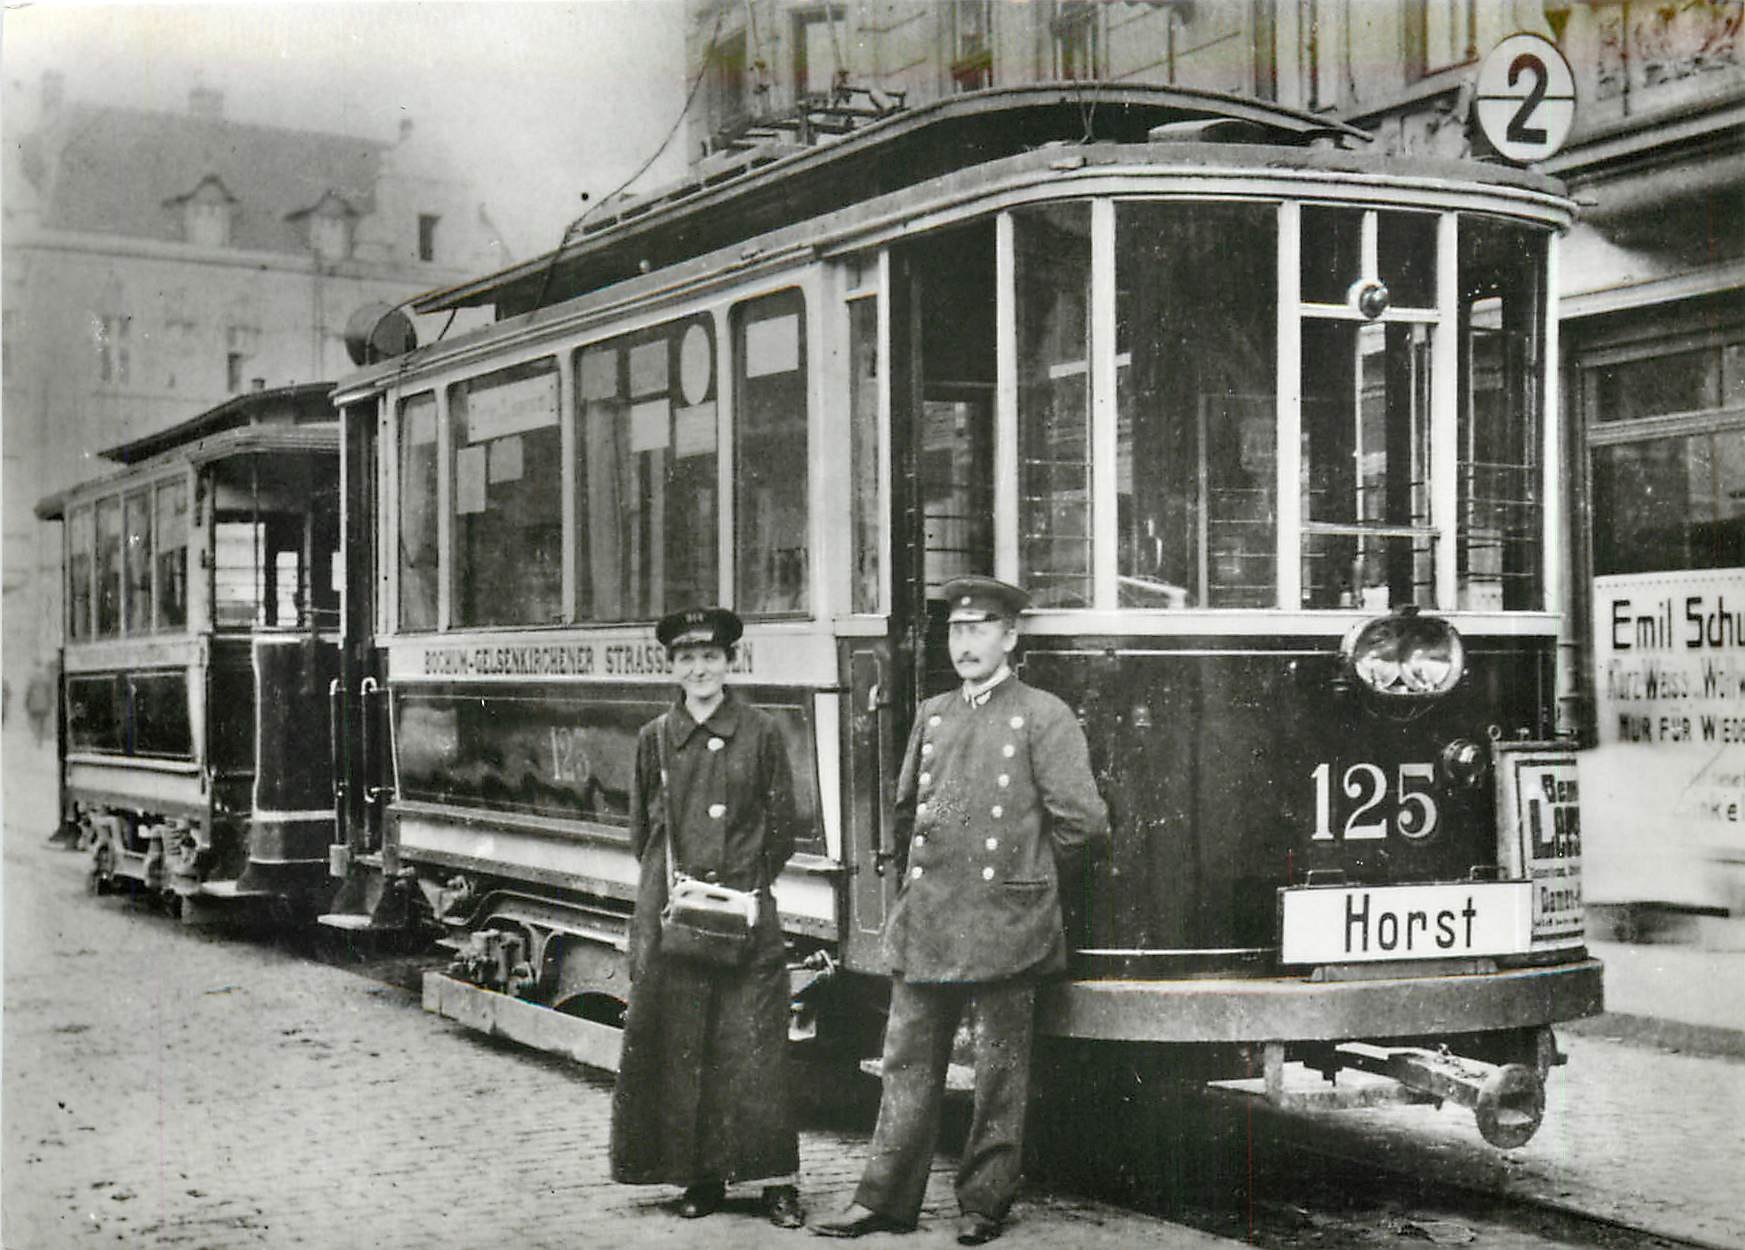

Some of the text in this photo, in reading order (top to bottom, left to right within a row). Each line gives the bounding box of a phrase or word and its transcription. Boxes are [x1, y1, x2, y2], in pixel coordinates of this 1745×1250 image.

[1506, 53, 1548, 144] 2
[1612, 598, 1672, 649] Emil
[1311, 763, 1438, 841] 125
[1345, 894, 1477, 954] Horst
